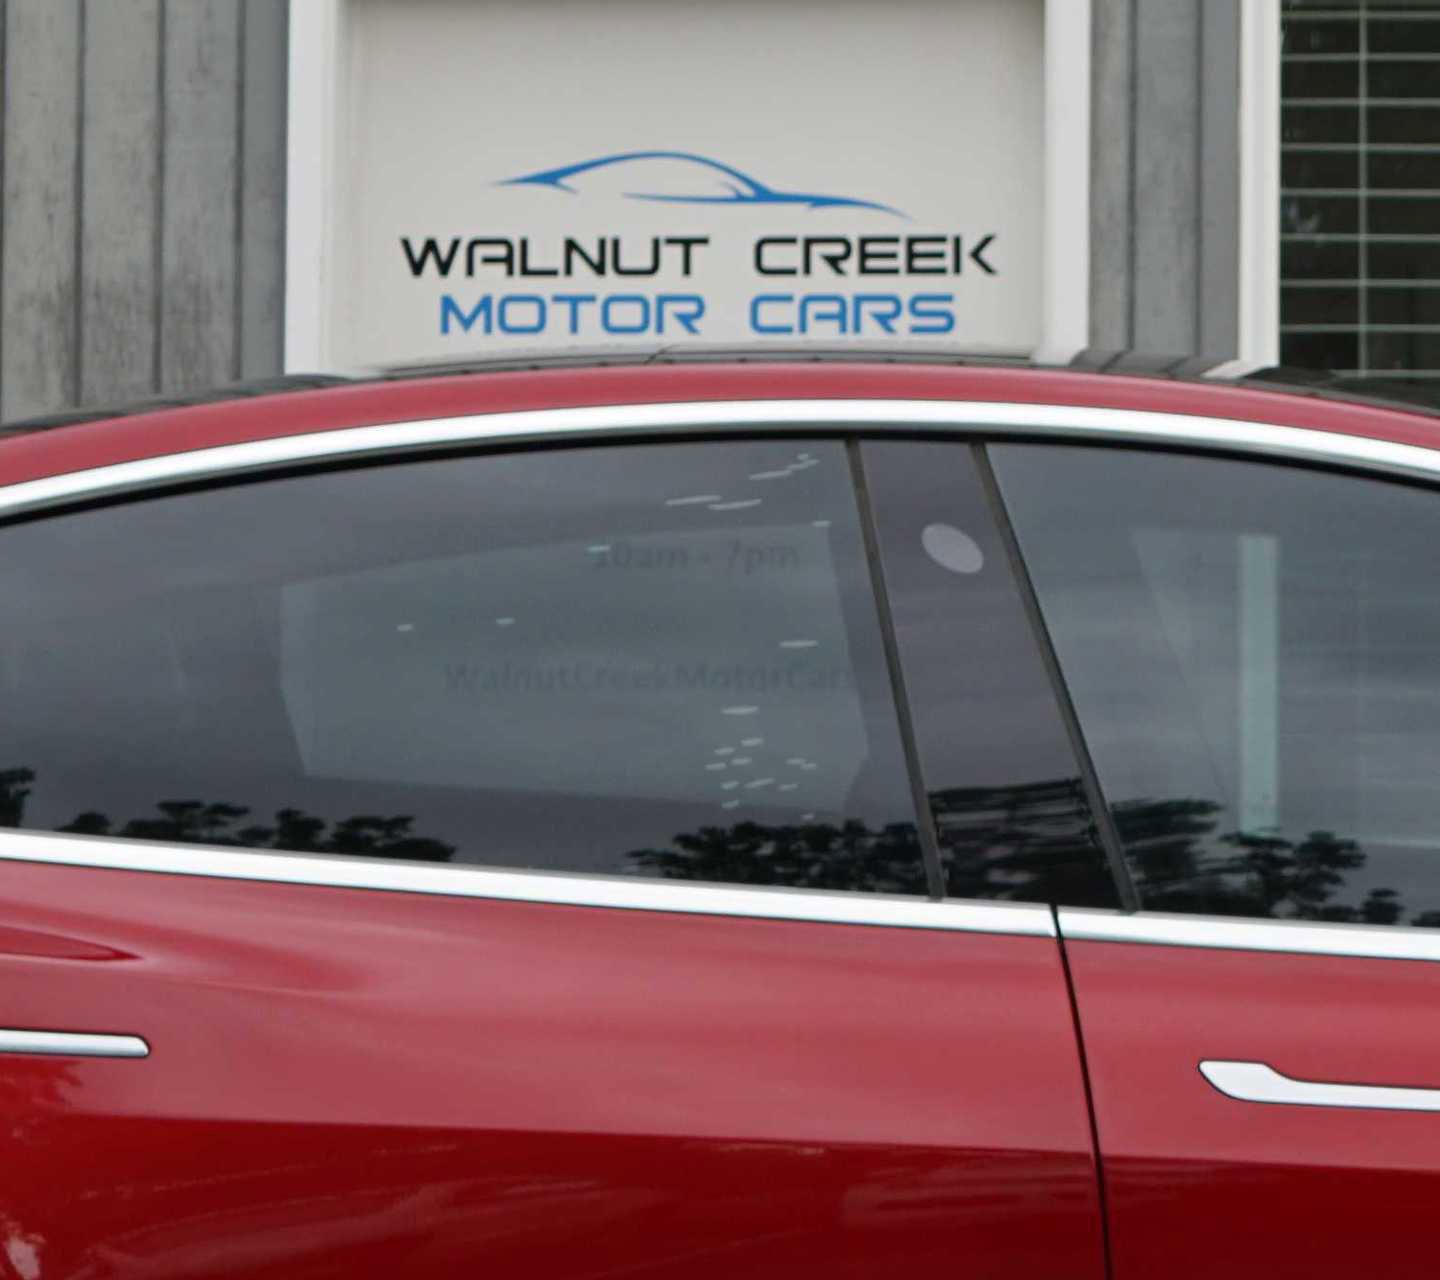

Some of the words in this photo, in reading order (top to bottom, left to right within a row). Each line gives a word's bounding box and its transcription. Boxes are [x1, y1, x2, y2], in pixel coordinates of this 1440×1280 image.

[400, 237, 710, 278] WALNUT
[754, 234, 997, 276] CREEK
[440, 292, 706, 336] MOTOR
[747, 292, 957, 336] CARS
